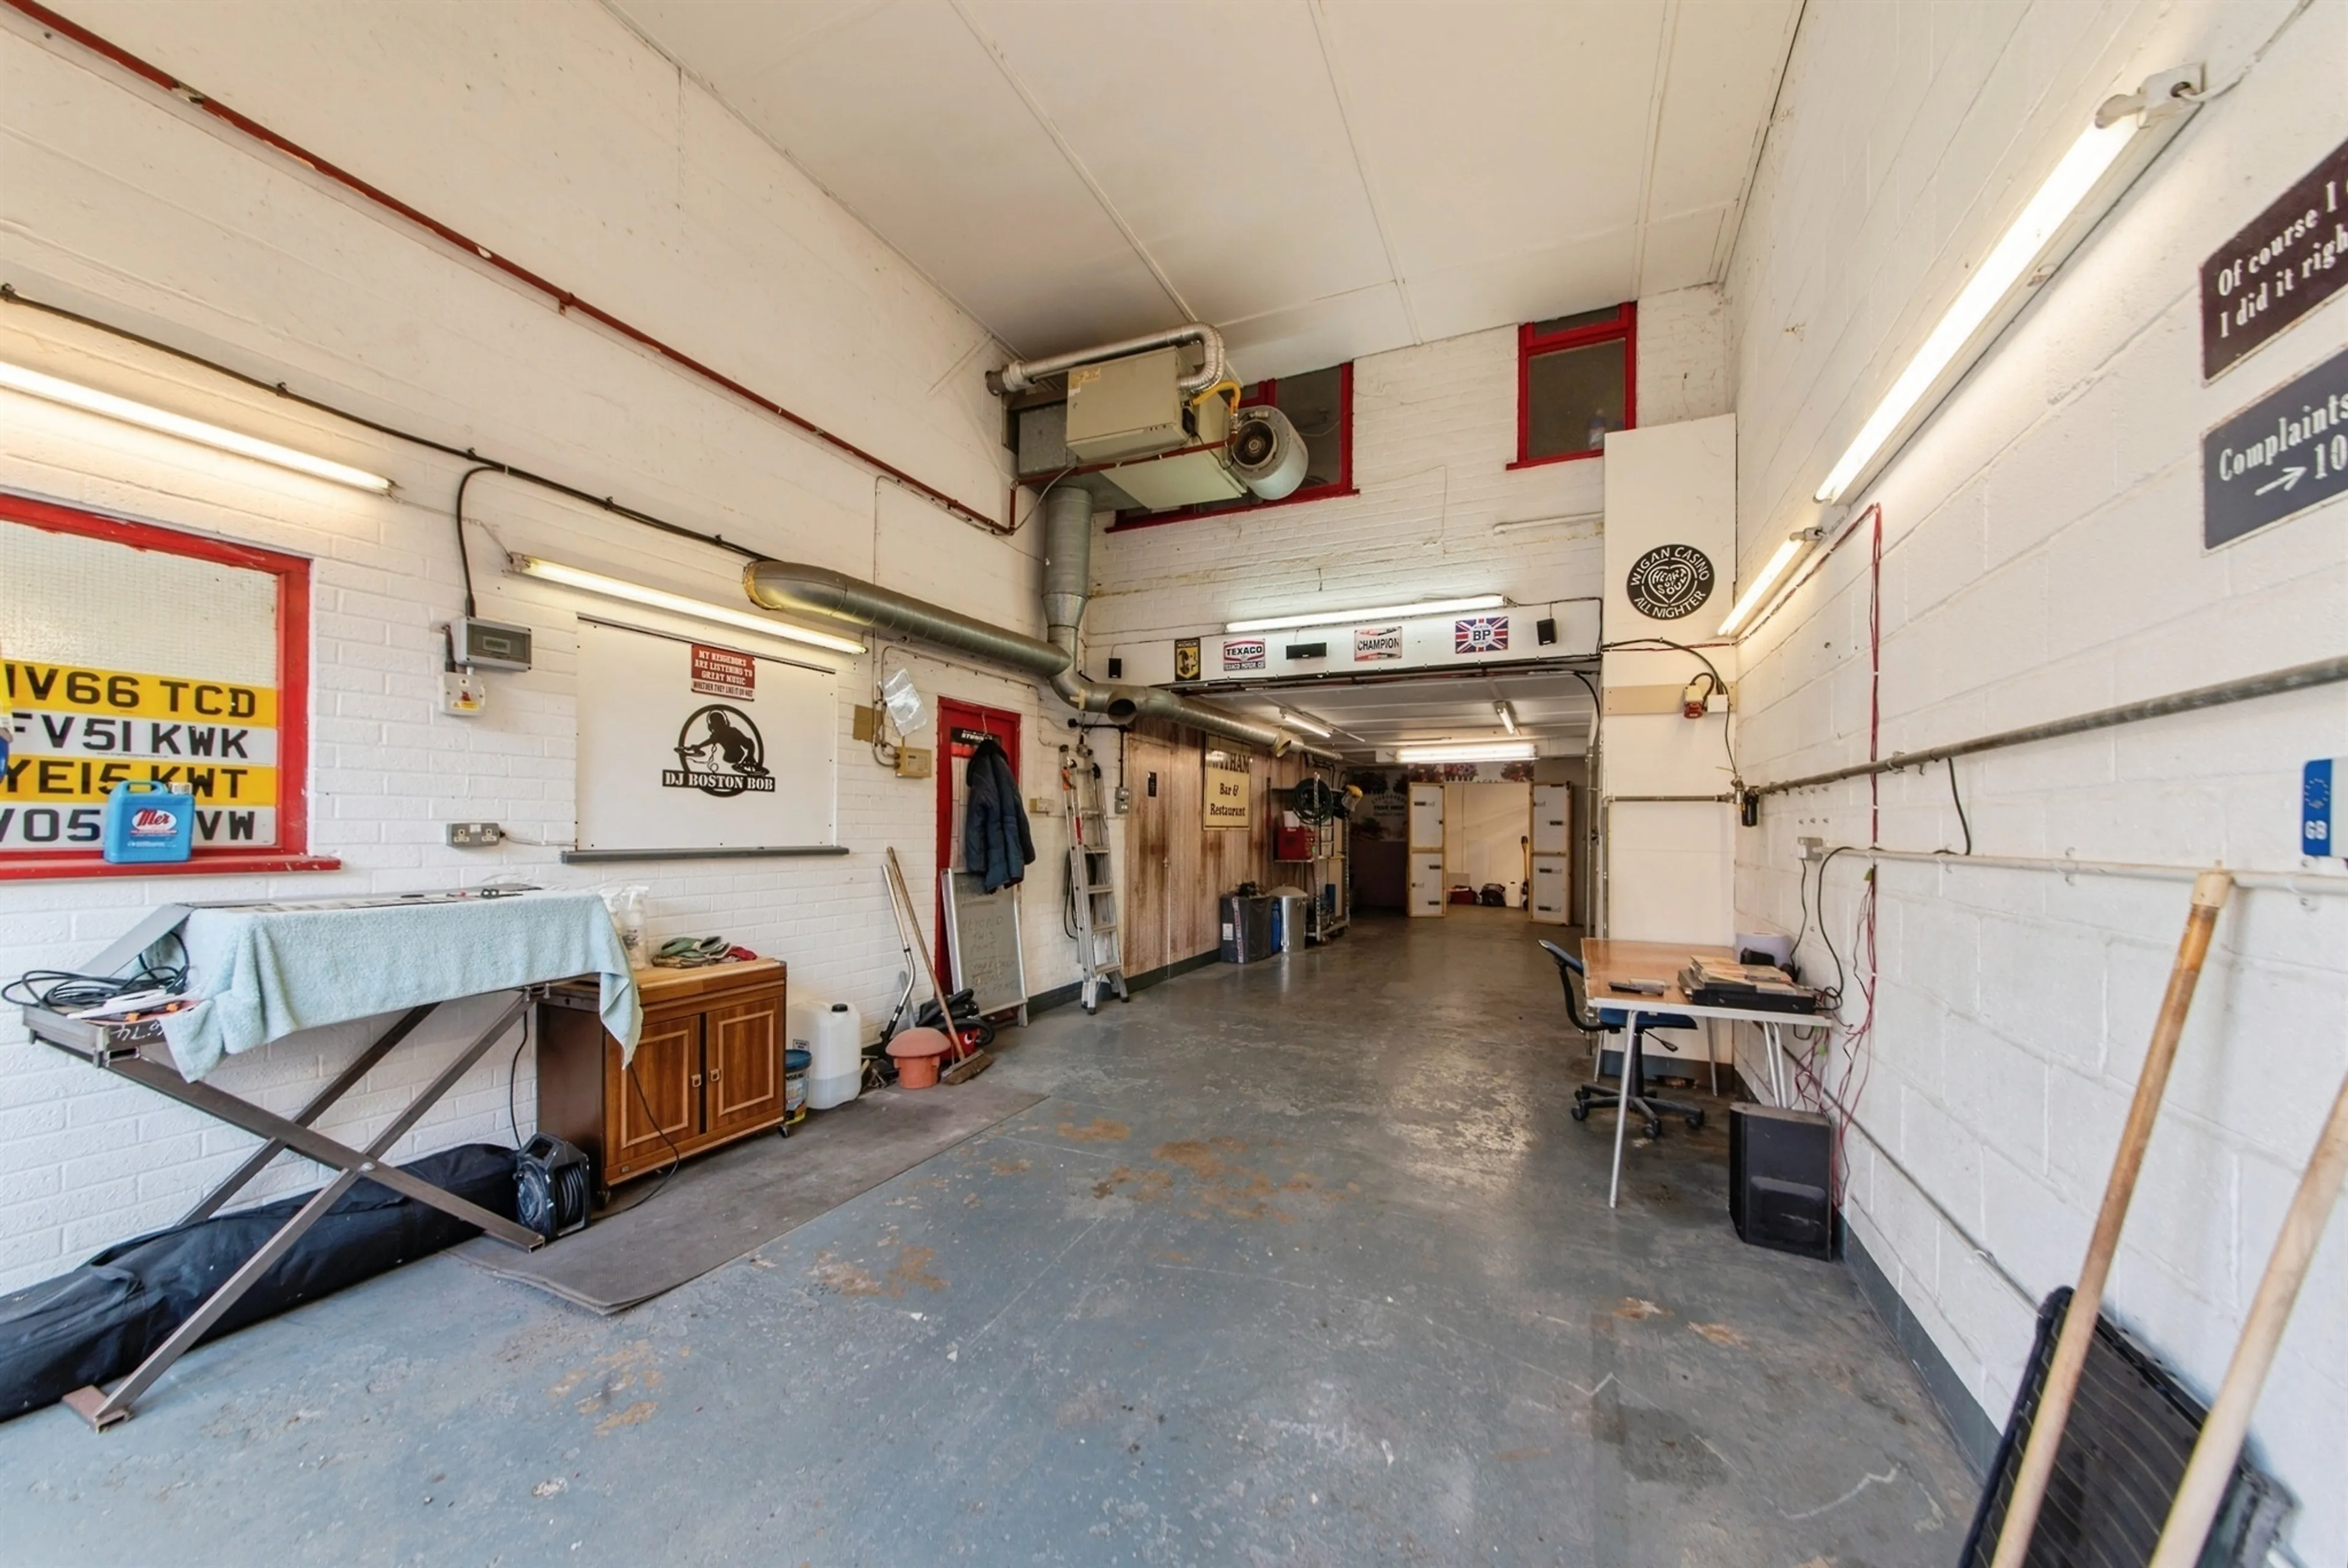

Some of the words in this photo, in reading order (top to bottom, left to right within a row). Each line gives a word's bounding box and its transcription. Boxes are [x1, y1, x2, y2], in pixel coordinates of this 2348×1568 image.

[2218, 259, 2243, 296] Of
[2248, 209, 2318, 273] course
[2326, 181, 2337, 213] I
[2221, 311, 2229, 338] I
[2236, 282, 2268, 325] did
[2276, 268, 2294, 297] it
[2220, 393, 2348, 481] Complaints
[1630, 547, 1670, 586] WIGAN
[1675, 547, 1710, 581] CASINO
[1652, 569, 1687, 584] HEART
[1656, 576, 1687, 594] SOUL
[1634, 597, 1651, 614] ALL
[1652, 591, 1706, 617] NIGHTER
[1473, 629, 1491, 641] BP
[1226, 646, 1262, 656] TEXACO
[1357, 638, 1399, 651] CHAMPION
[699, 650, 710, 659] MY
[695, 659, 708, 669] ARE
[710, 662, 743, 675] LISTENING
[744, 669, 753, 677] TO
[701, 670, 725, 681] GREAT
[726, 674, 746, 685] MUSIC
[160, 680, 256, 718] TCD
[151, 723, 248, 759] KWK
[665, 771, 684, 785] DJ
[688, 773, 744, 789] BOSTON
[747, 776, 773, 790] BOB
[1220, 782, 1231, 795] Bar
[136, 808, 171, 827] Mer
[1210, 803, 1246, 817] Restaurant
[197, 811, 255, 841] VW
